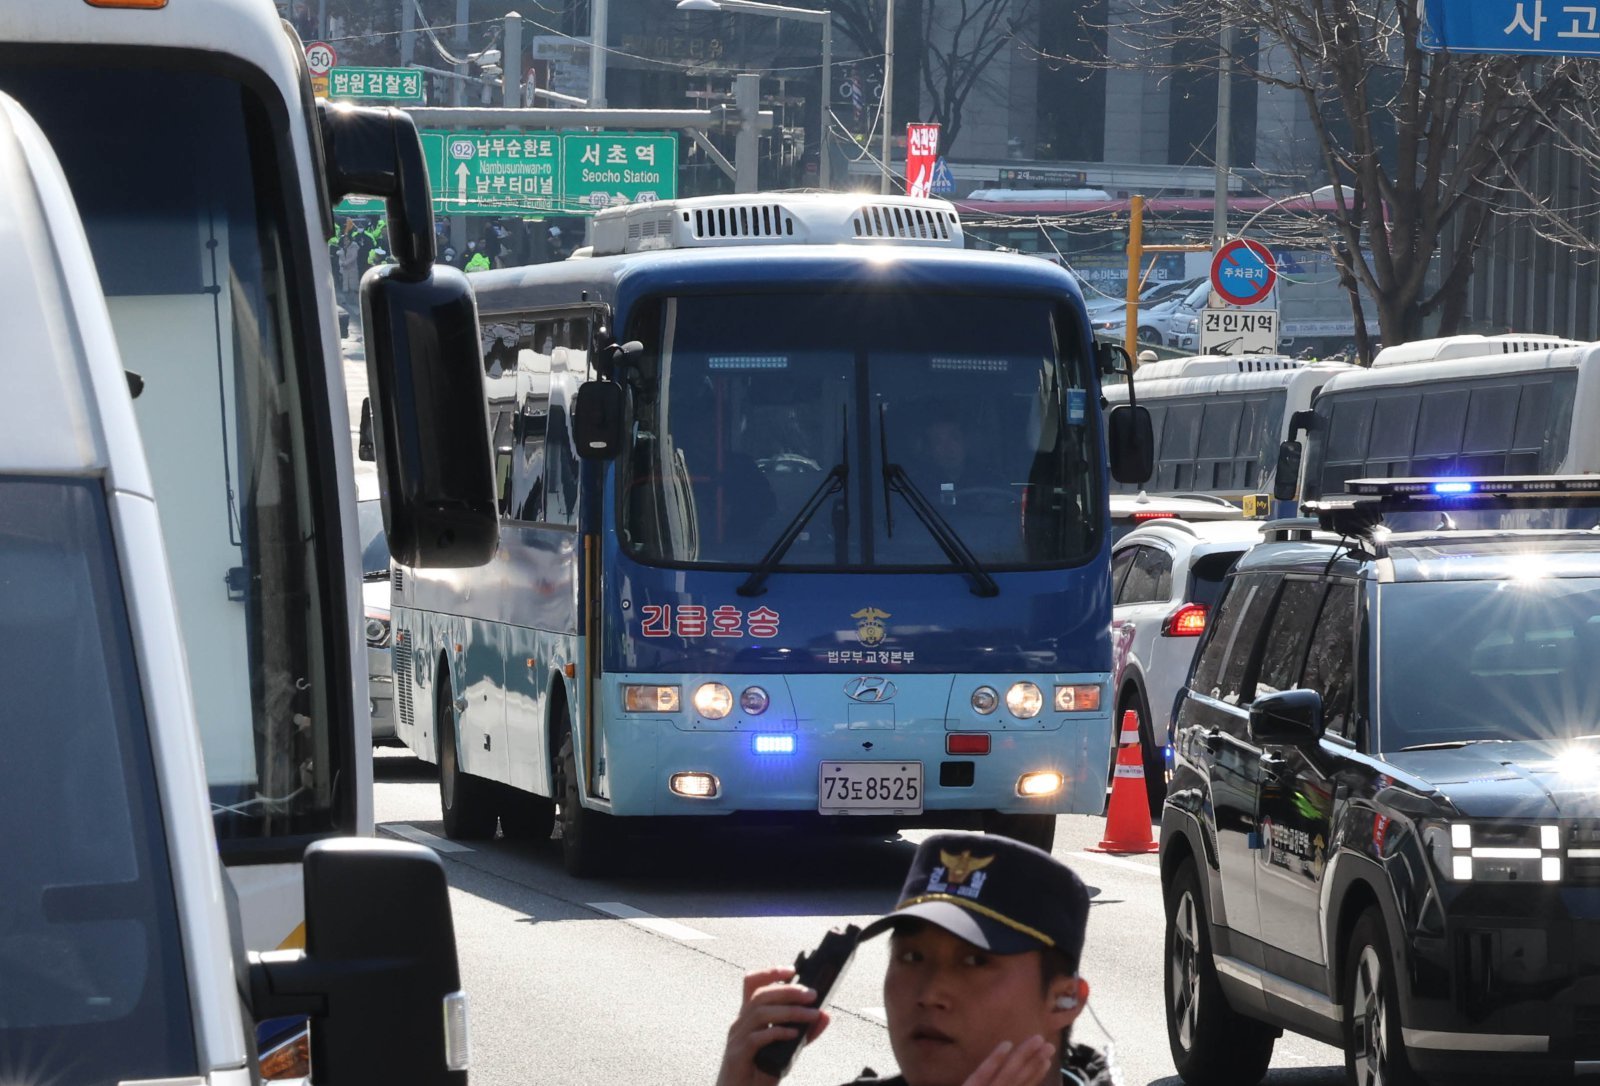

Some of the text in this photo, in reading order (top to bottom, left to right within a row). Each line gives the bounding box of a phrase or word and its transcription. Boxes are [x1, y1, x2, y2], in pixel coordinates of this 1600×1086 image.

[1504, 0, 1600, 41] 사고
[311, 51, 330, 67] 50
[334, 73, 417, 94] 법원검찰청
[454, 144, 471, 155] 92
[476, 139, 553, 158] 남부순환로
[580, 143, 655, 166] 서초역
[479, 160, 552, 175] Nambusunhwan-ro
[582, 169, 660, 183] Seocho Station
[476, 176, 553, 194] 남부터미널
[1223, 267, 1264, 280] 주차금지
[1204, 313, 1273, 333] 견인지역
[641, 605, 780, 638] 긴급호송
[823, 776, 918, 802] 73도8525
